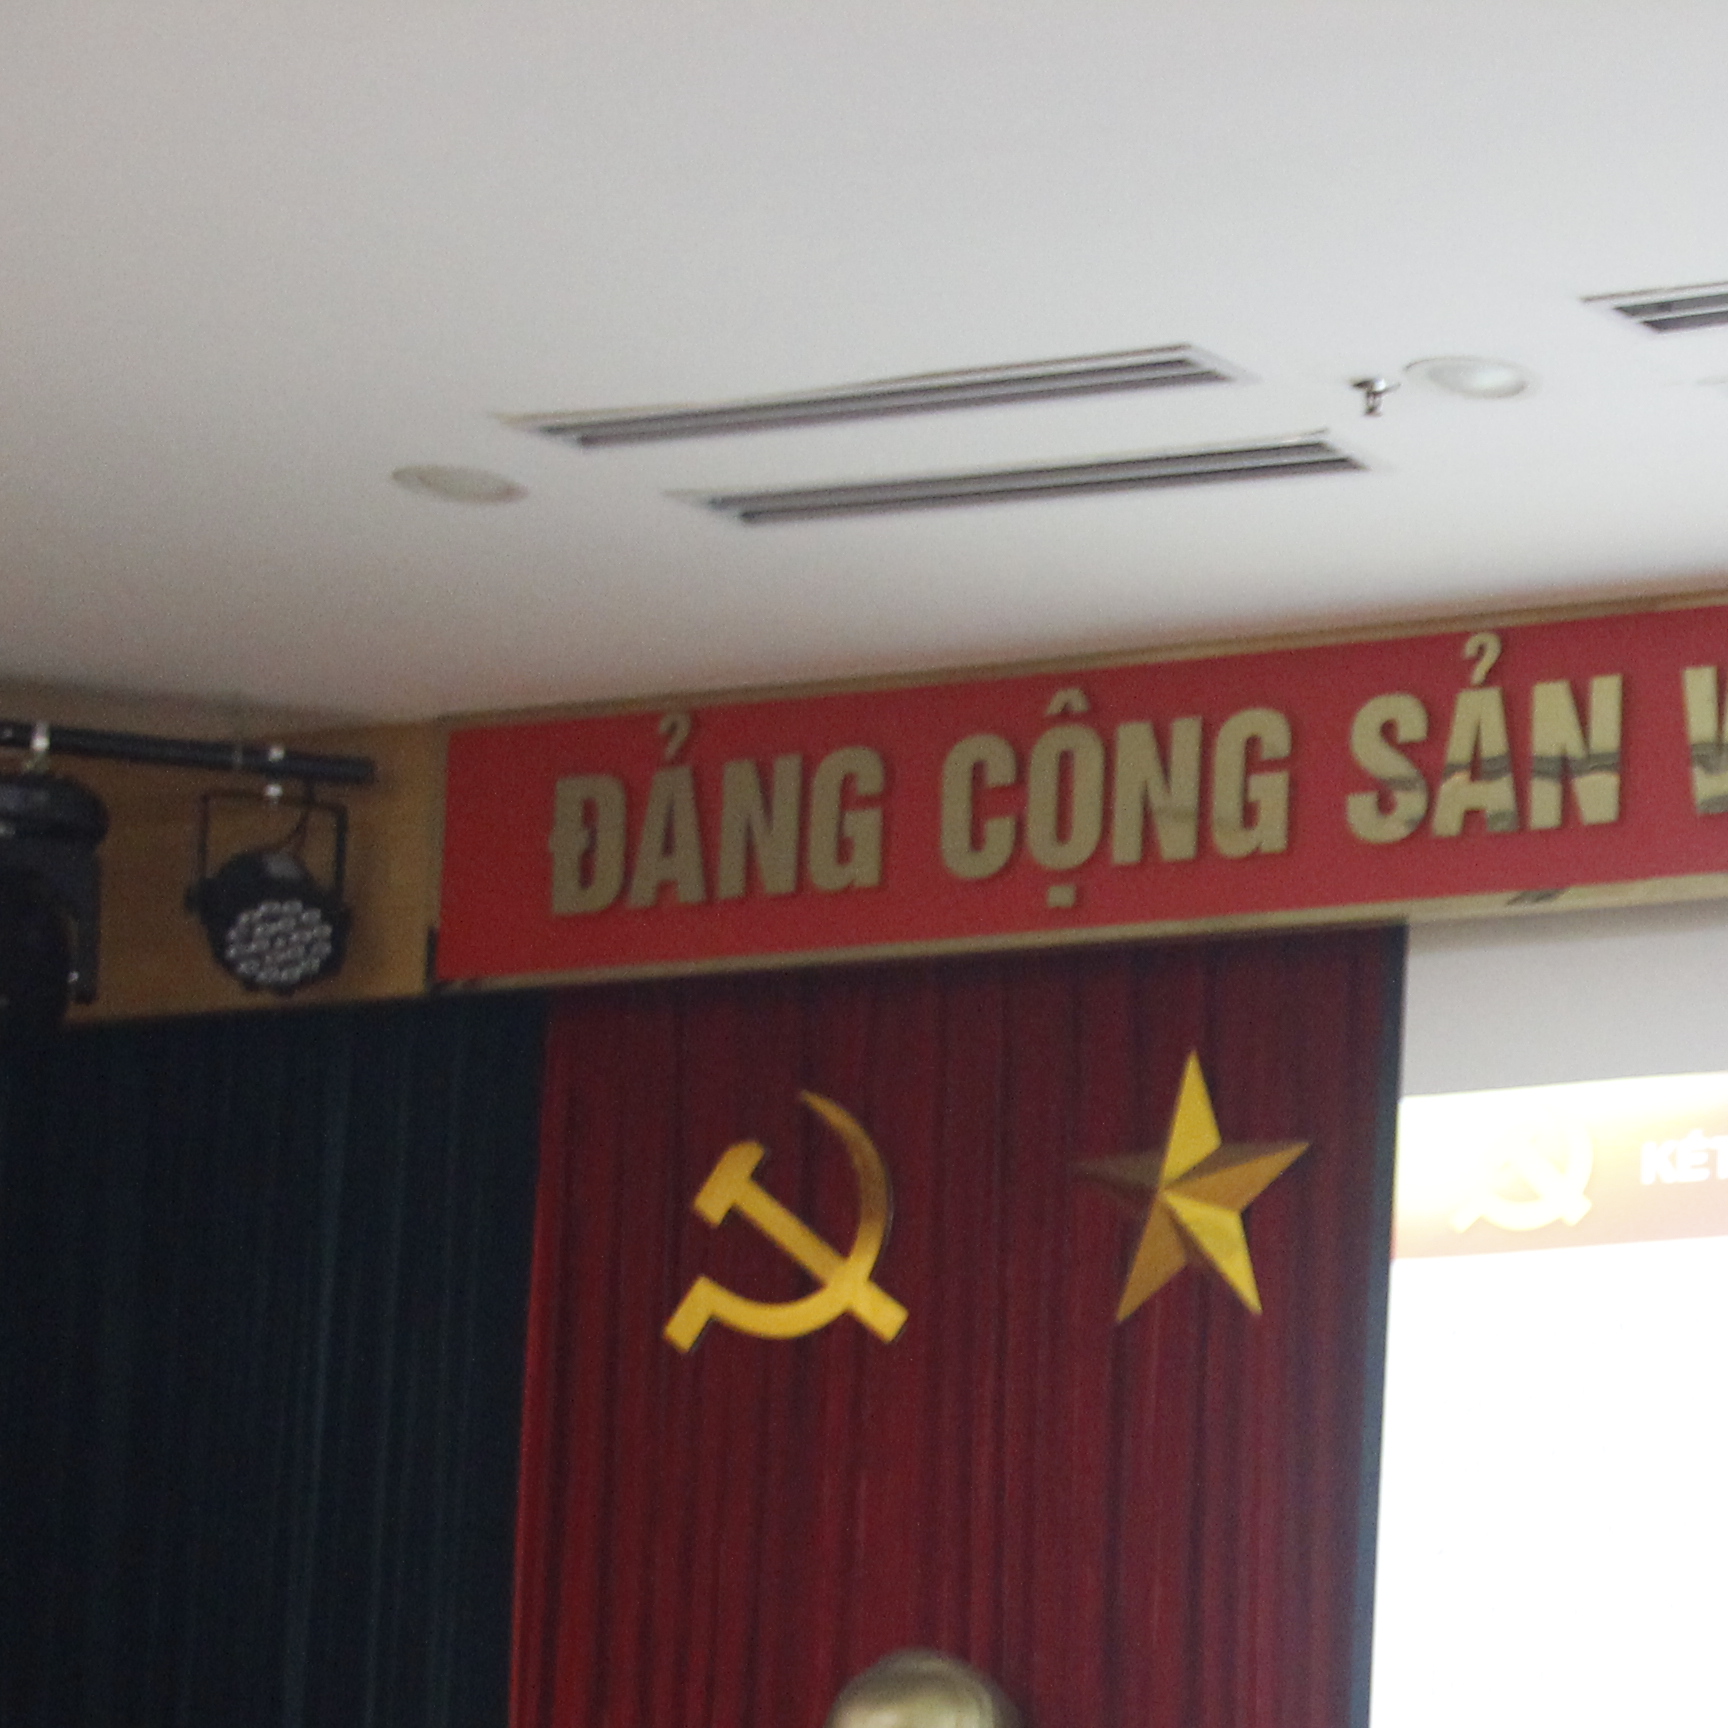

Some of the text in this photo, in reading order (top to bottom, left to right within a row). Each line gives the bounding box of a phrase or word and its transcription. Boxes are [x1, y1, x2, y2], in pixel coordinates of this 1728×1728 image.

[549, 712, 885, 914] ĐẢNG
[940, 688, 1293, 908] CỘNG
[1345, 631, 1624, 845] SẢN
